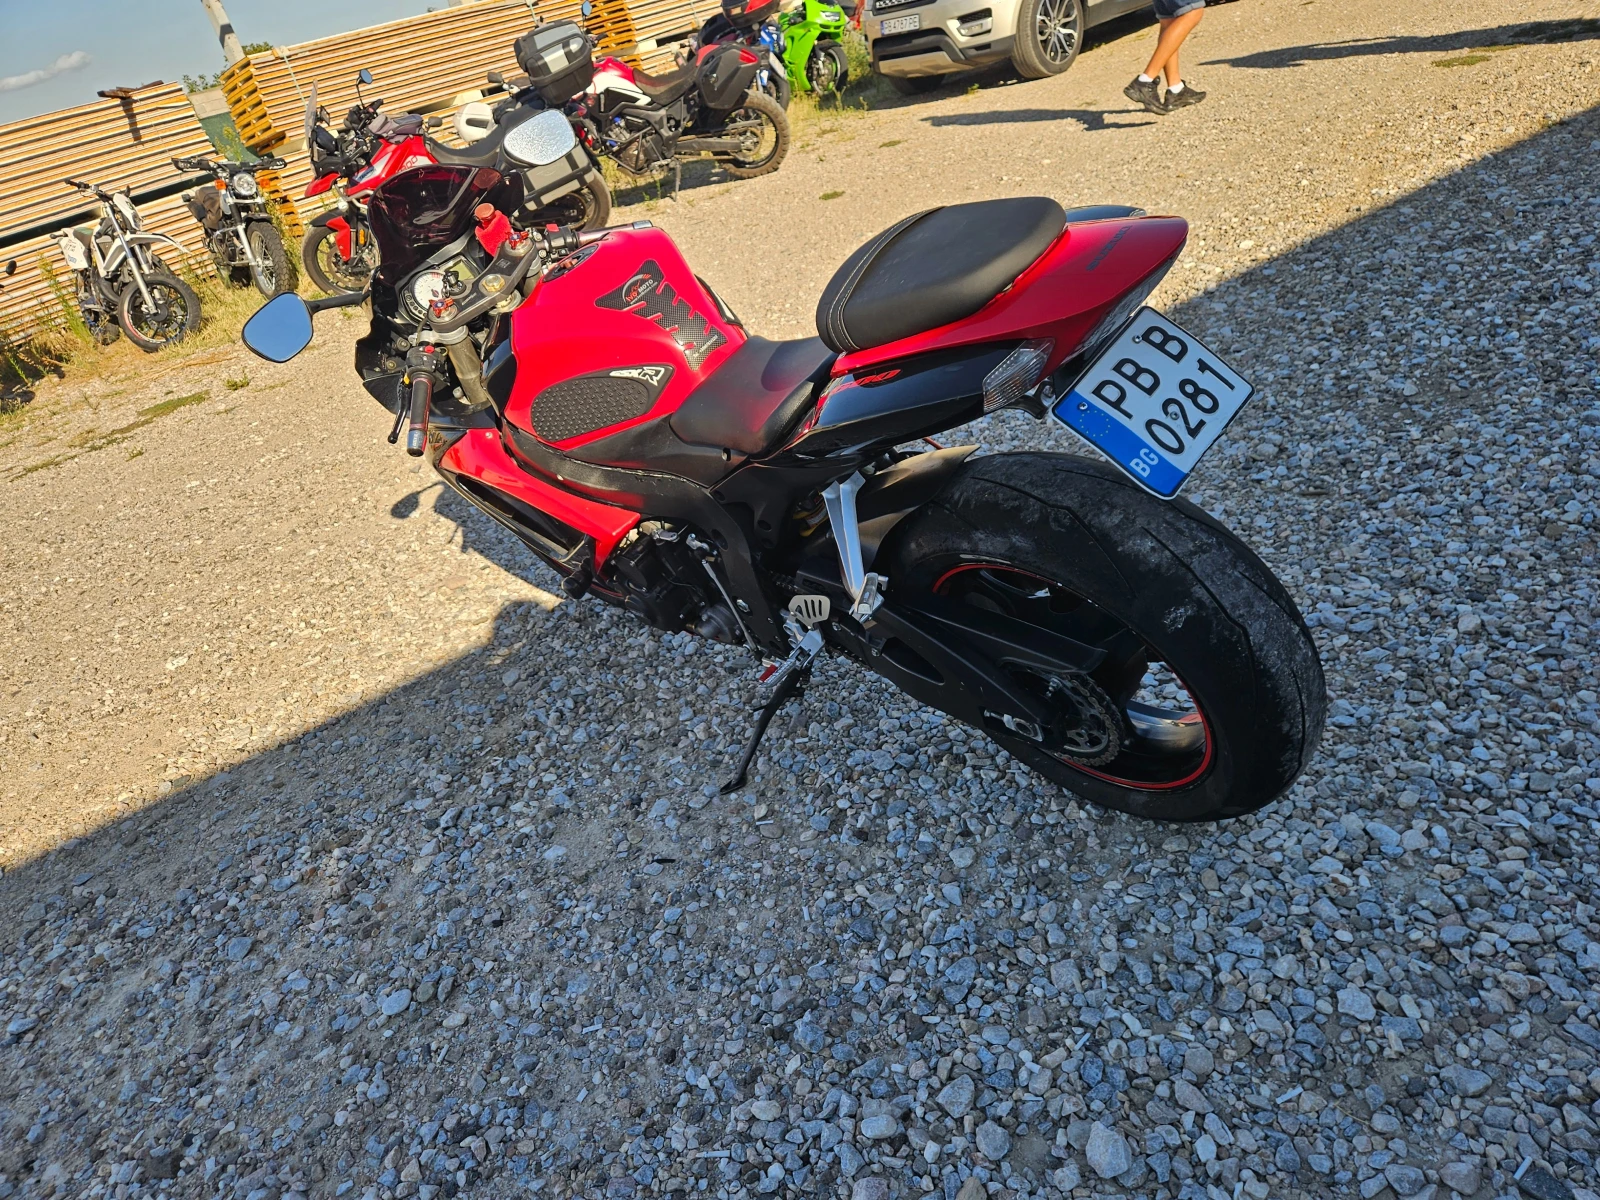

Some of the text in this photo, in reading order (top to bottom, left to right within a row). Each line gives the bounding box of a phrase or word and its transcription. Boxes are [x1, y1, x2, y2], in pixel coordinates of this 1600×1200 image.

[638, 279, 654, 293] MOTO
[1145, 358, 1236, 455] 0281
[1129, 448, 1159, 478] BG
